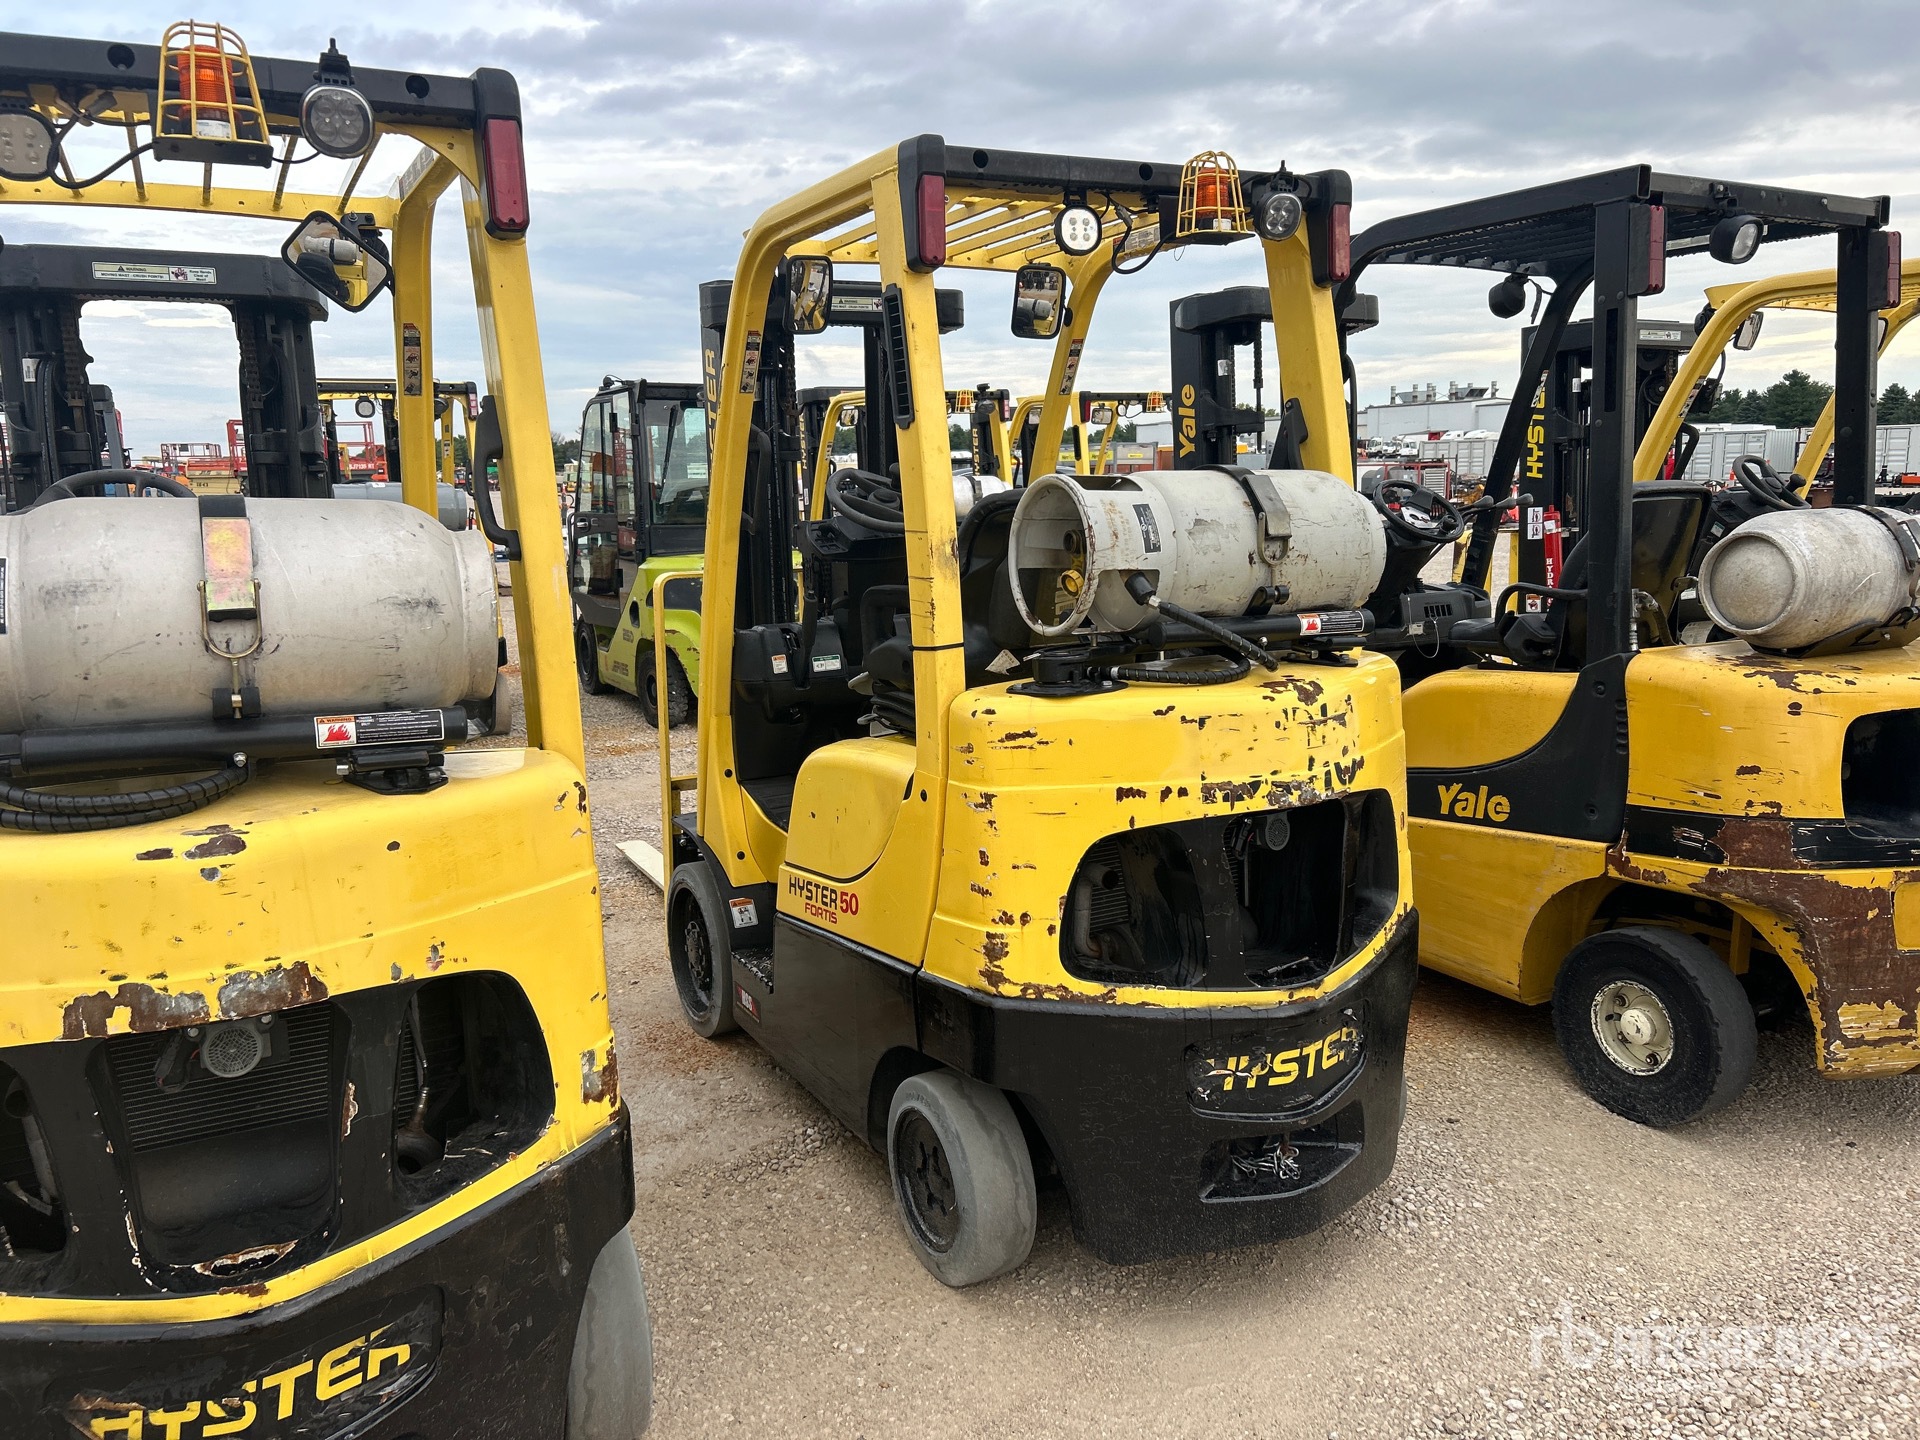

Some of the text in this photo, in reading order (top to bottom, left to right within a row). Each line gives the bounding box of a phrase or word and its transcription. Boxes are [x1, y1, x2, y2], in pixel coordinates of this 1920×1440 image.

[1178, 384, 1196, 459] Yale
[1526, 386, 1546, 479] HYSTE
[1438, 783, 1510, 822] Yale
[789, 874, 859, 916] HYSTER 50
[805, 902, 838, 925] FORTIS
